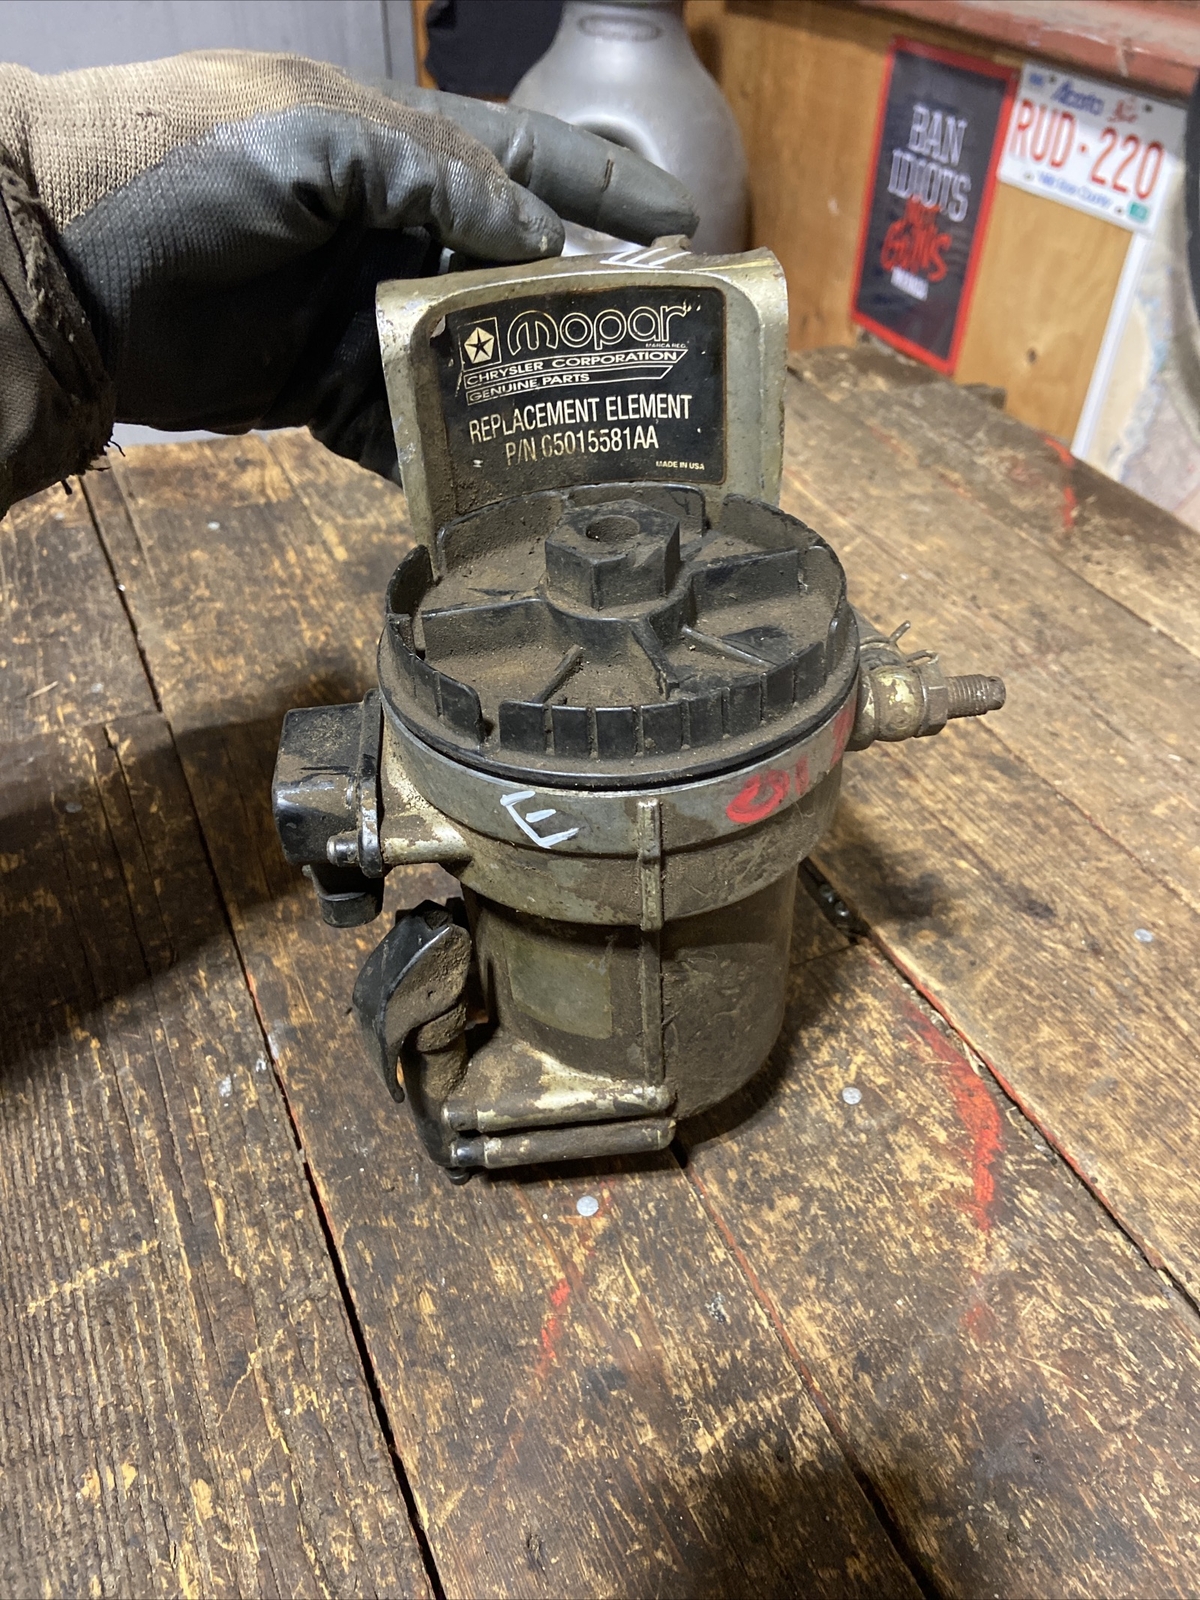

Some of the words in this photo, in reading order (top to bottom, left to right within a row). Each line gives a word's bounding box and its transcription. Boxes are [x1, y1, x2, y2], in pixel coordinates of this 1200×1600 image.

[907, 102, 968, 167] BAN
[887, 148, 972, 222] IDIOTS
[466, 361, 544, 385] CHRYSLER
[551, 350, 678, 369] CORPORATION
[469, 379, 538, 402] GENUINE
[542, 373, 590, 386] PARTS
[468, 397, 600, 445] REPLACEMENT
[605, 393, 693, 421] ELEMENT
[505, 436, 538, 467] P/N
[655, 460, 679, 468] MADE
[679, 461, 688, 469] IN
[688, 461, 705, 471] USA
[500, 789, 579, 849] E
